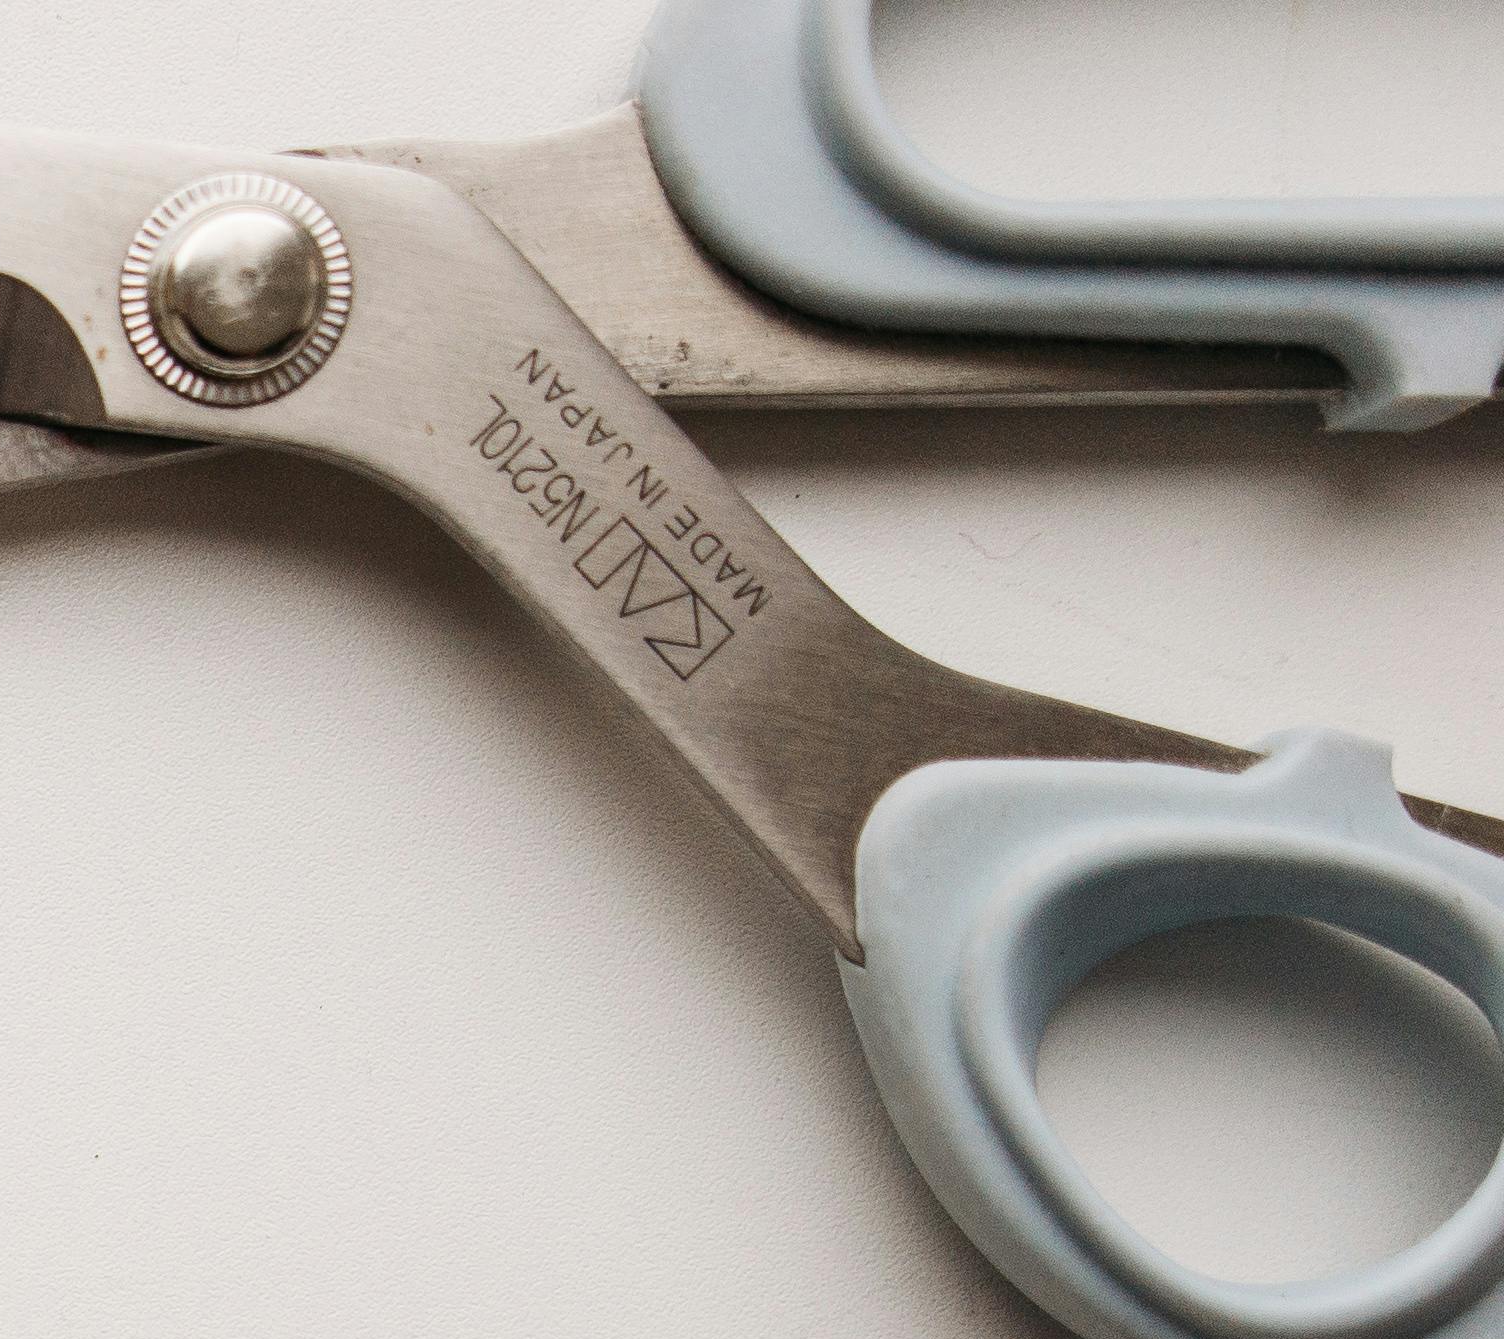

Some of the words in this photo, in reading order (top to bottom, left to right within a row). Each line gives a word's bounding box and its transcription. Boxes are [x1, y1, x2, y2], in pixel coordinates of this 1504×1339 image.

[515, 347, 633, 464] JAPAN
[625, 464, 670, 510] IN
[664, 504, 773, 617] MADE
